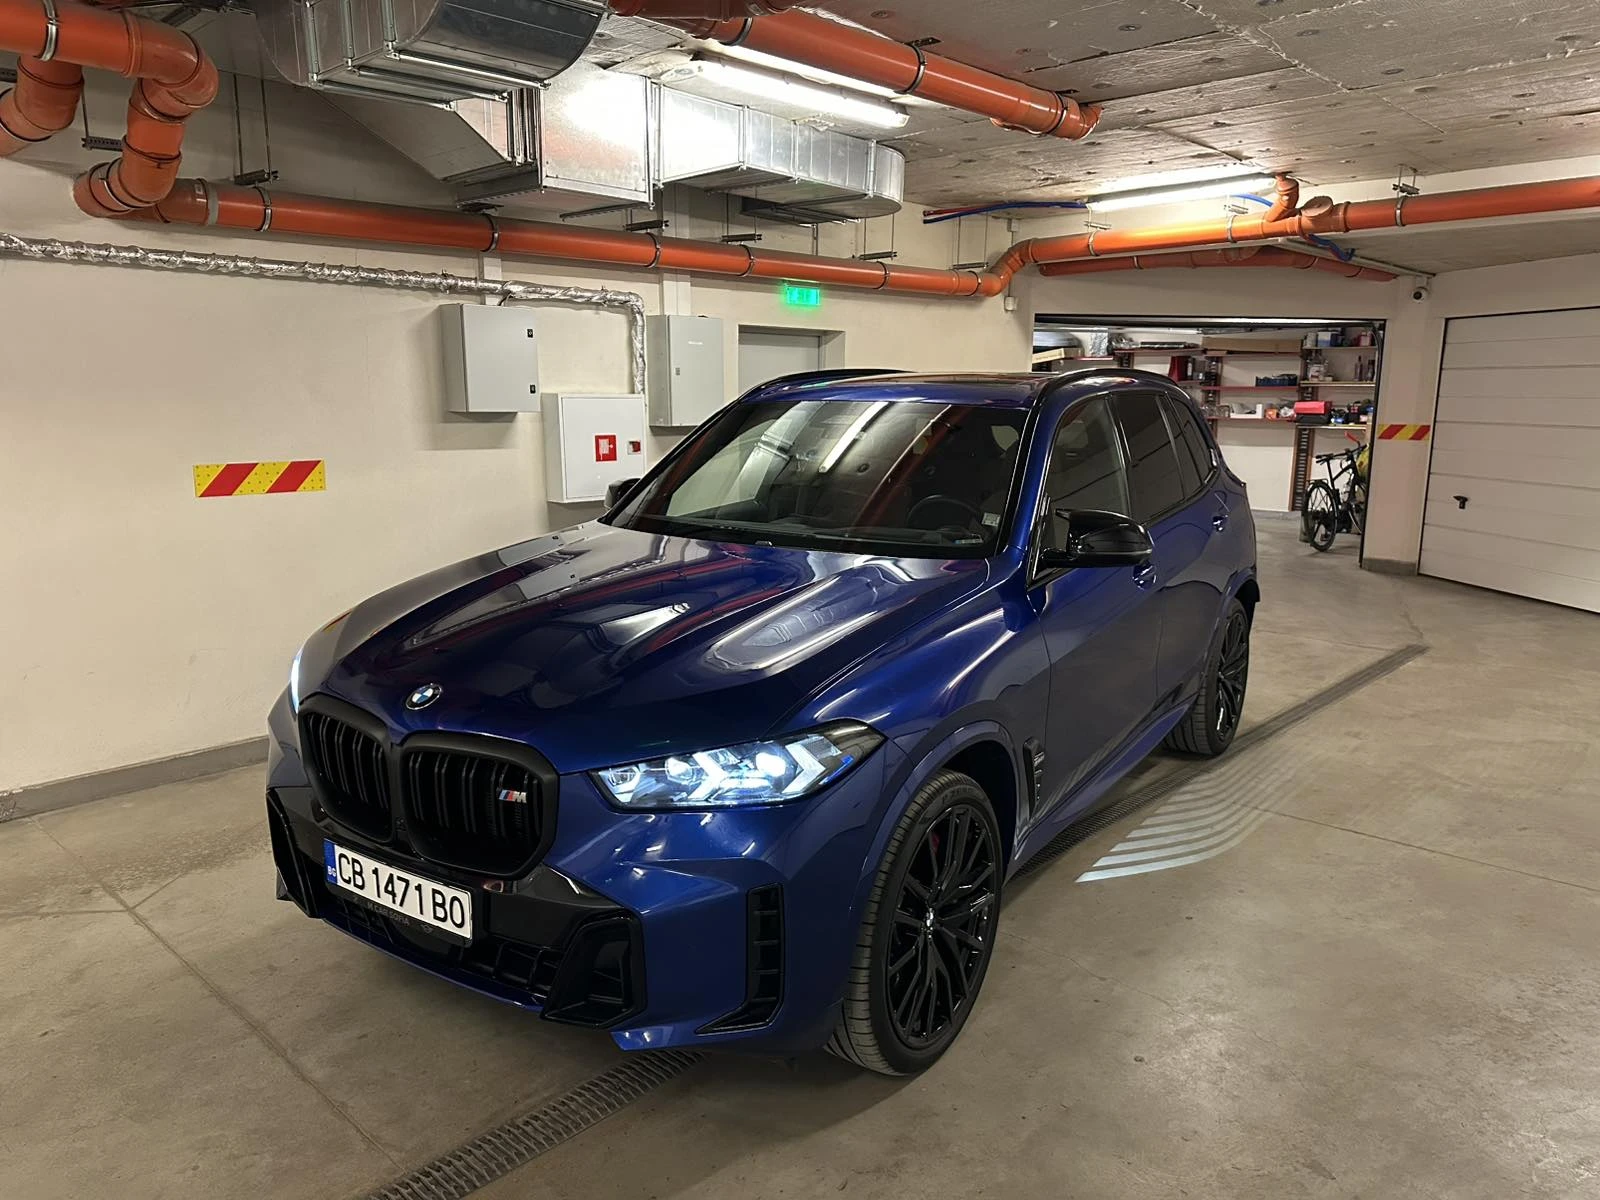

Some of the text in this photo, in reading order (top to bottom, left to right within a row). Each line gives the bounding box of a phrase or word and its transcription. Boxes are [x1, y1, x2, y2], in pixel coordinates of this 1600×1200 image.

[327, 865, 337, 877] BG
[338, 852, 465, 929] CB 1471 BO
